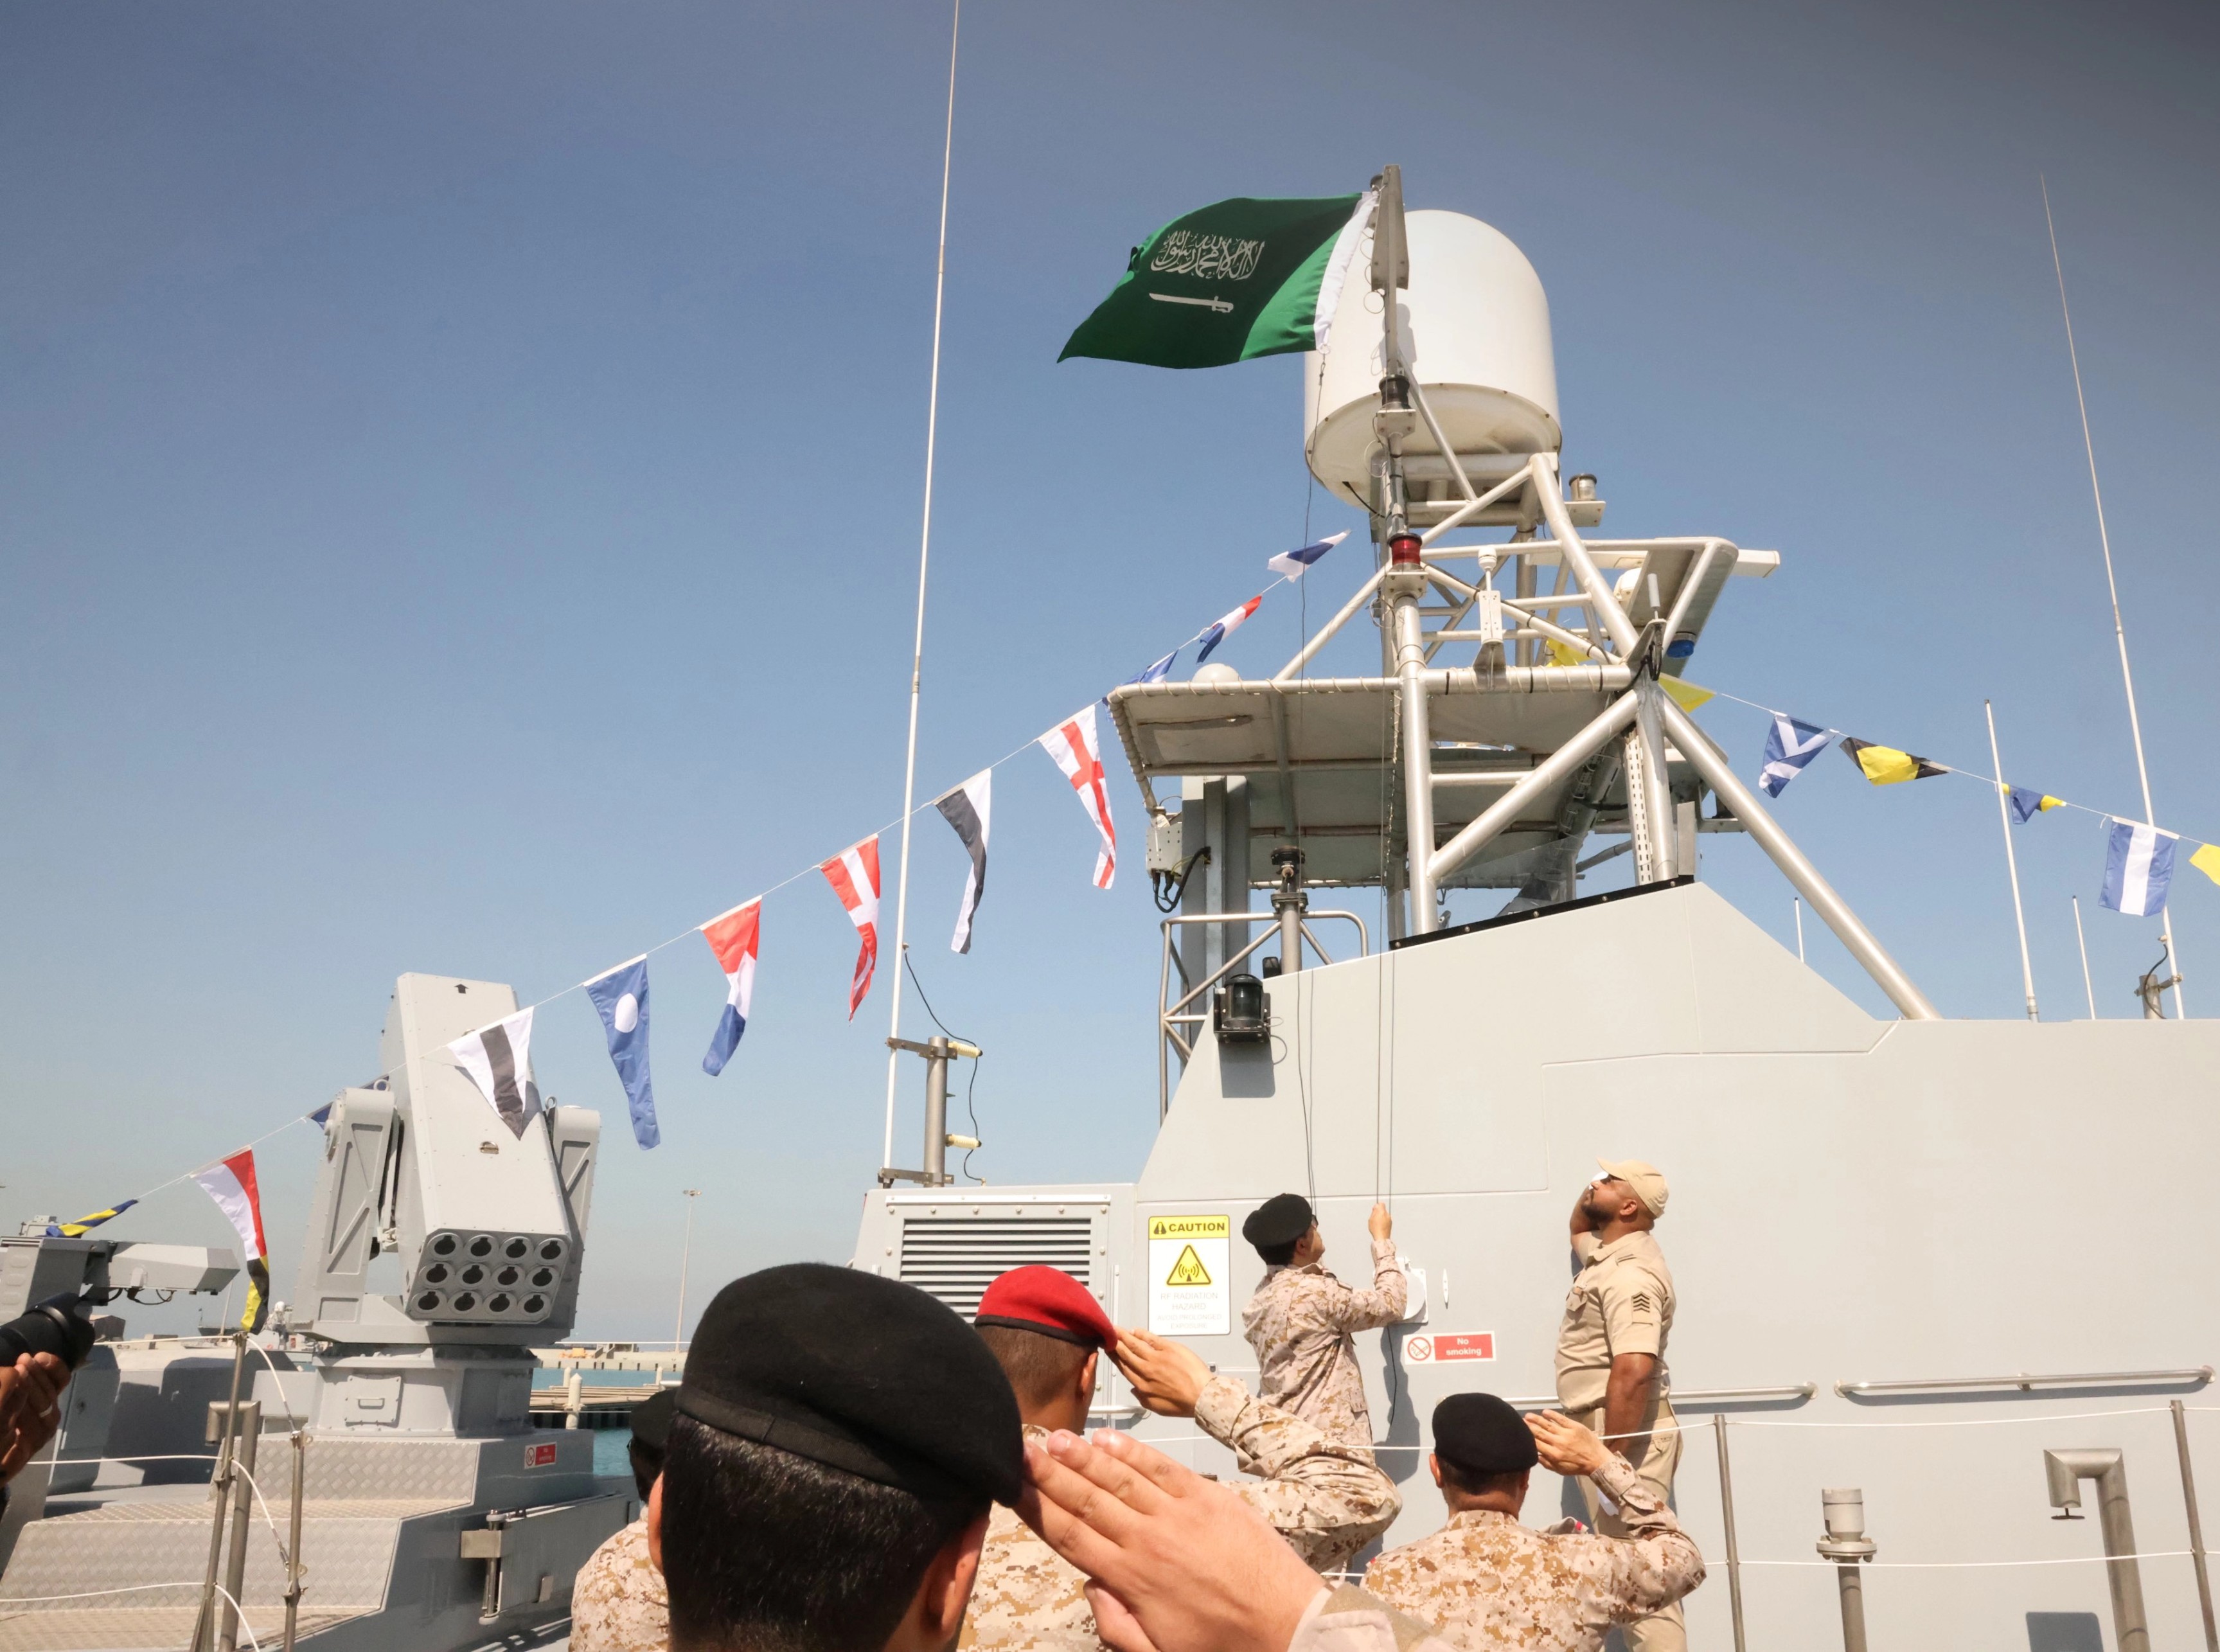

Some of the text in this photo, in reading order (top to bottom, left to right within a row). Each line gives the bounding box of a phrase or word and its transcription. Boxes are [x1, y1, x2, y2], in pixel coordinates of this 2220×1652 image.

[1169, 1222, 1225, 1232] CAUTION
[1173, 1292, 1218, 1300] RADIATION
[1446, 1347, 1482, 1356] smoking
